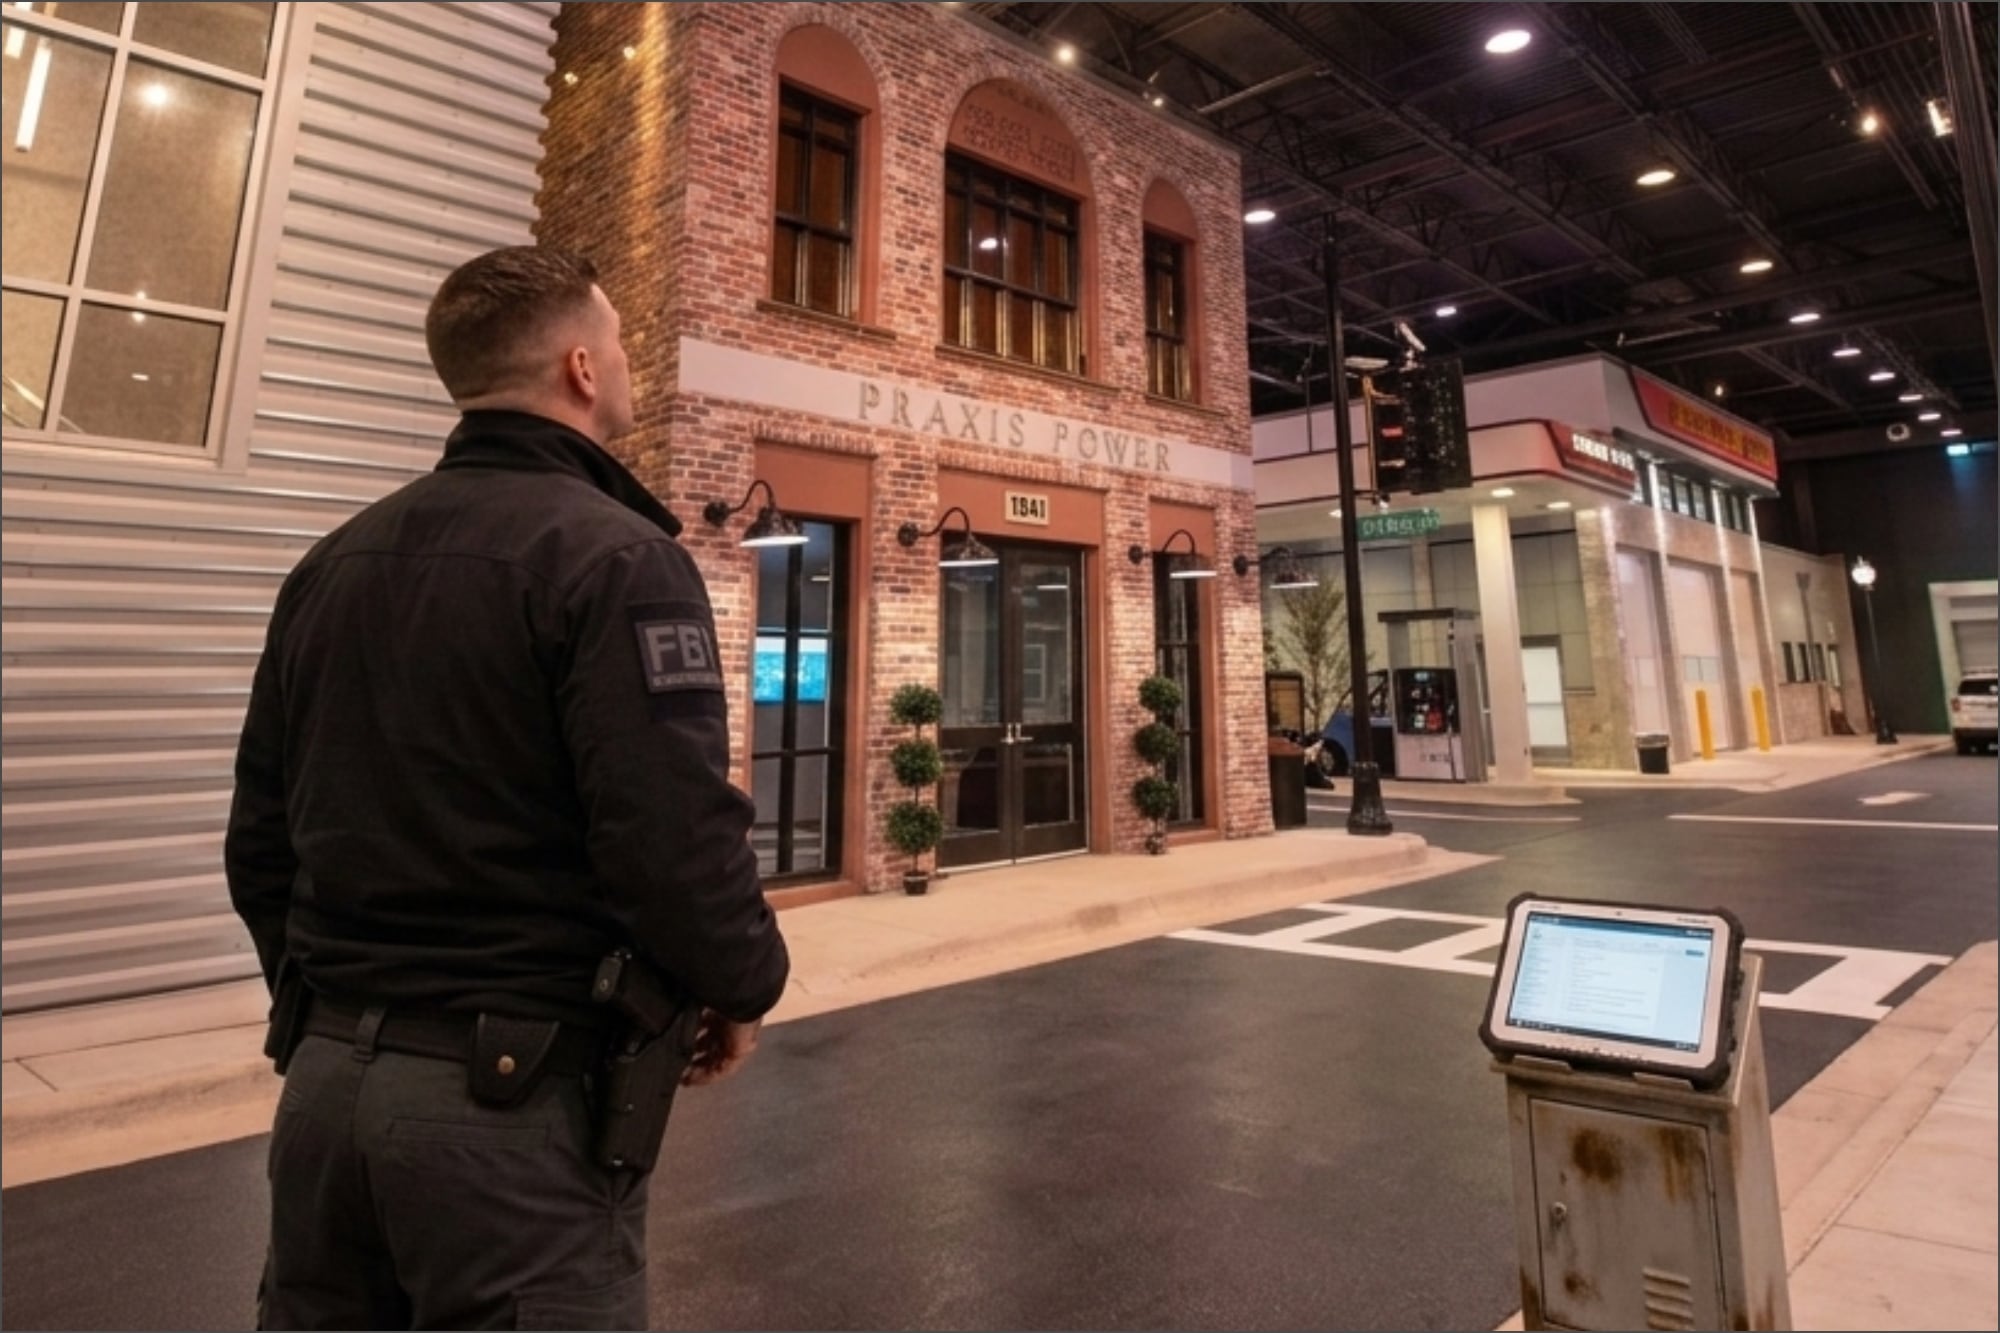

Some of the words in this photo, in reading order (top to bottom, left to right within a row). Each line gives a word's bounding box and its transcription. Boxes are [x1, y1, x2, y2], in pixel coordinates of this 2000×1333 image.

[858, 381, 1025, 448] PRAXIS
[1052, 422, 1171, 472] POWER
[645, 624, 717, 672] FBI
